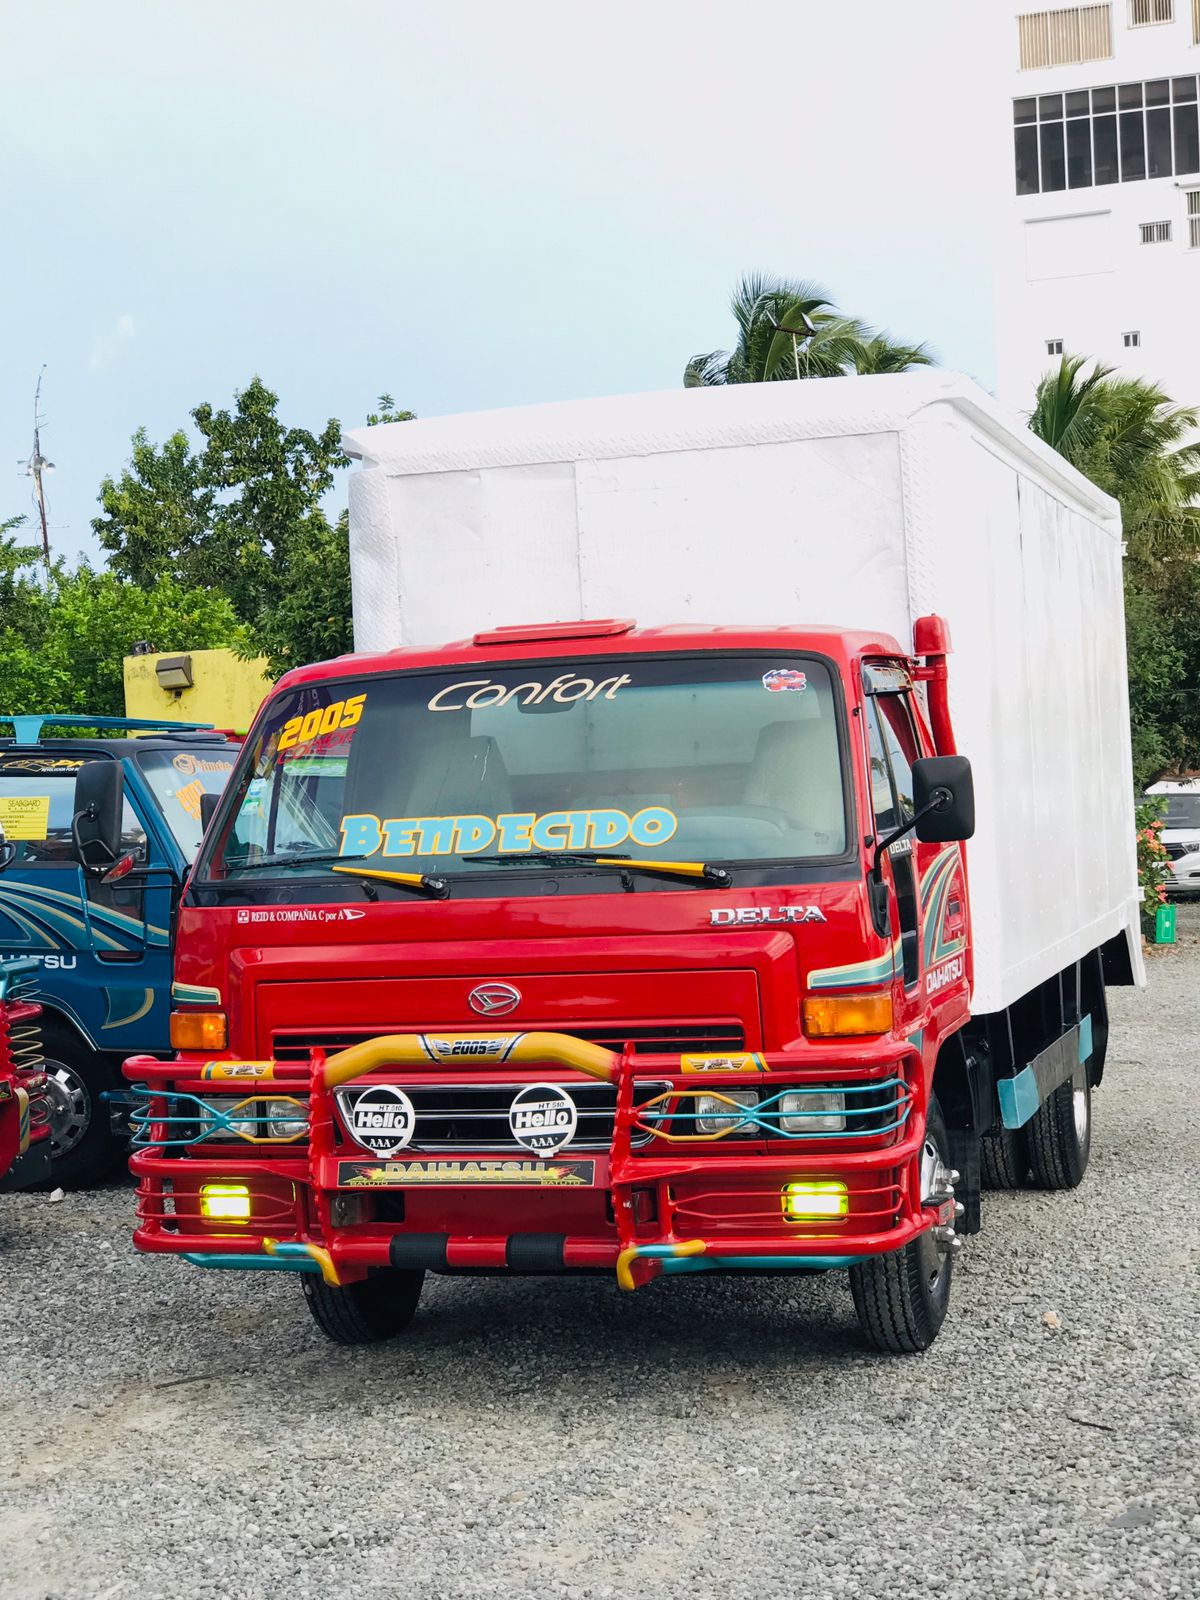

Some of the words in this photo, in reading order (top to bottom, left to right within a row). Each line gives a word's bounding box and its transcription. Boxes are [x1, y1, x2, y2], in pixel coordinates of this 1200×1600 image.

[427, 673, 632, 711] Confort
[277, 693, 367, 751] 2005
[339, 807, 678, 858] BENDECIDO
[889, 839, 913, 854] DELTA
[251, 911, 269, 922] REID
[270, 911, 276, 921] &
[318, 910, 325, 920] C
[325, 912, 336, 922] por
[337, 910, 344, 920] A
[710, 906, 827, 925] DELTA
[926, 956, 963, 995] DAIHATSU
[357, 1112, 405, 1129] Hello
[515, 1110, 569, 1129] Hello
[385, 1162, 547, 1181] DAIHATSU
